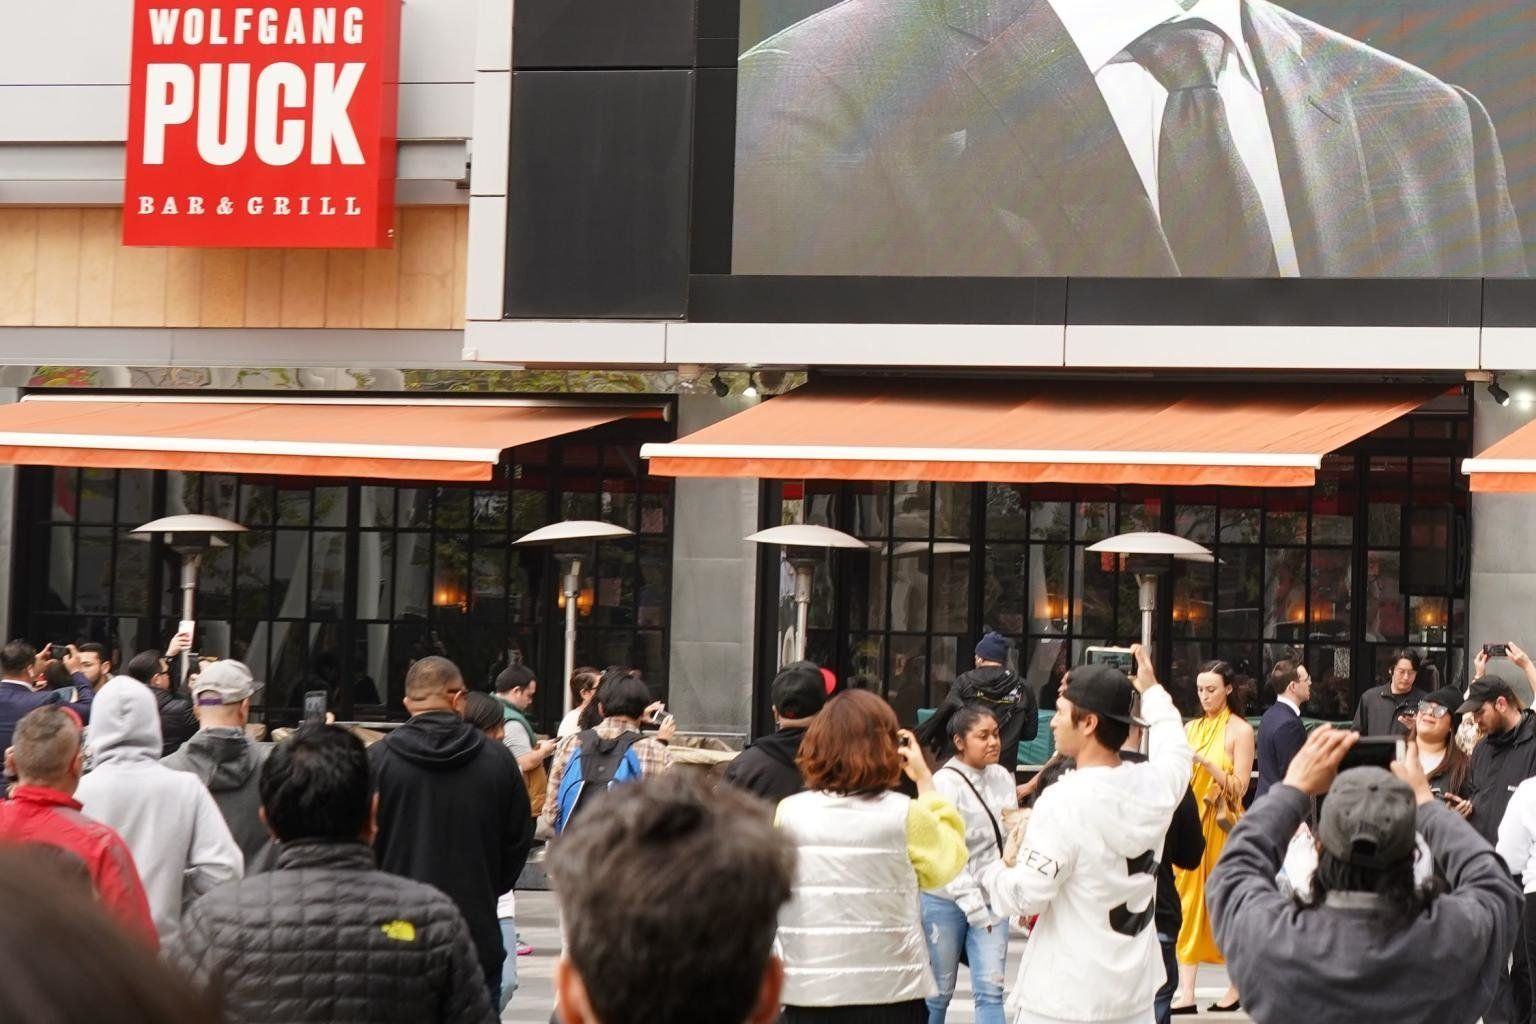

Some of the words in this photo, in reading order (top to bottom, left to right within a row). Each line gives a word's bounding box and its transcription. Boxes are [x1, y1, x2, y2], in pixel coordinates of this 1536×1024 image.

[149, 6, 363, 45] WOLFGANG
[142, 61, 366, 166] PUCK
[247, 196, 361, 216] GRILL
